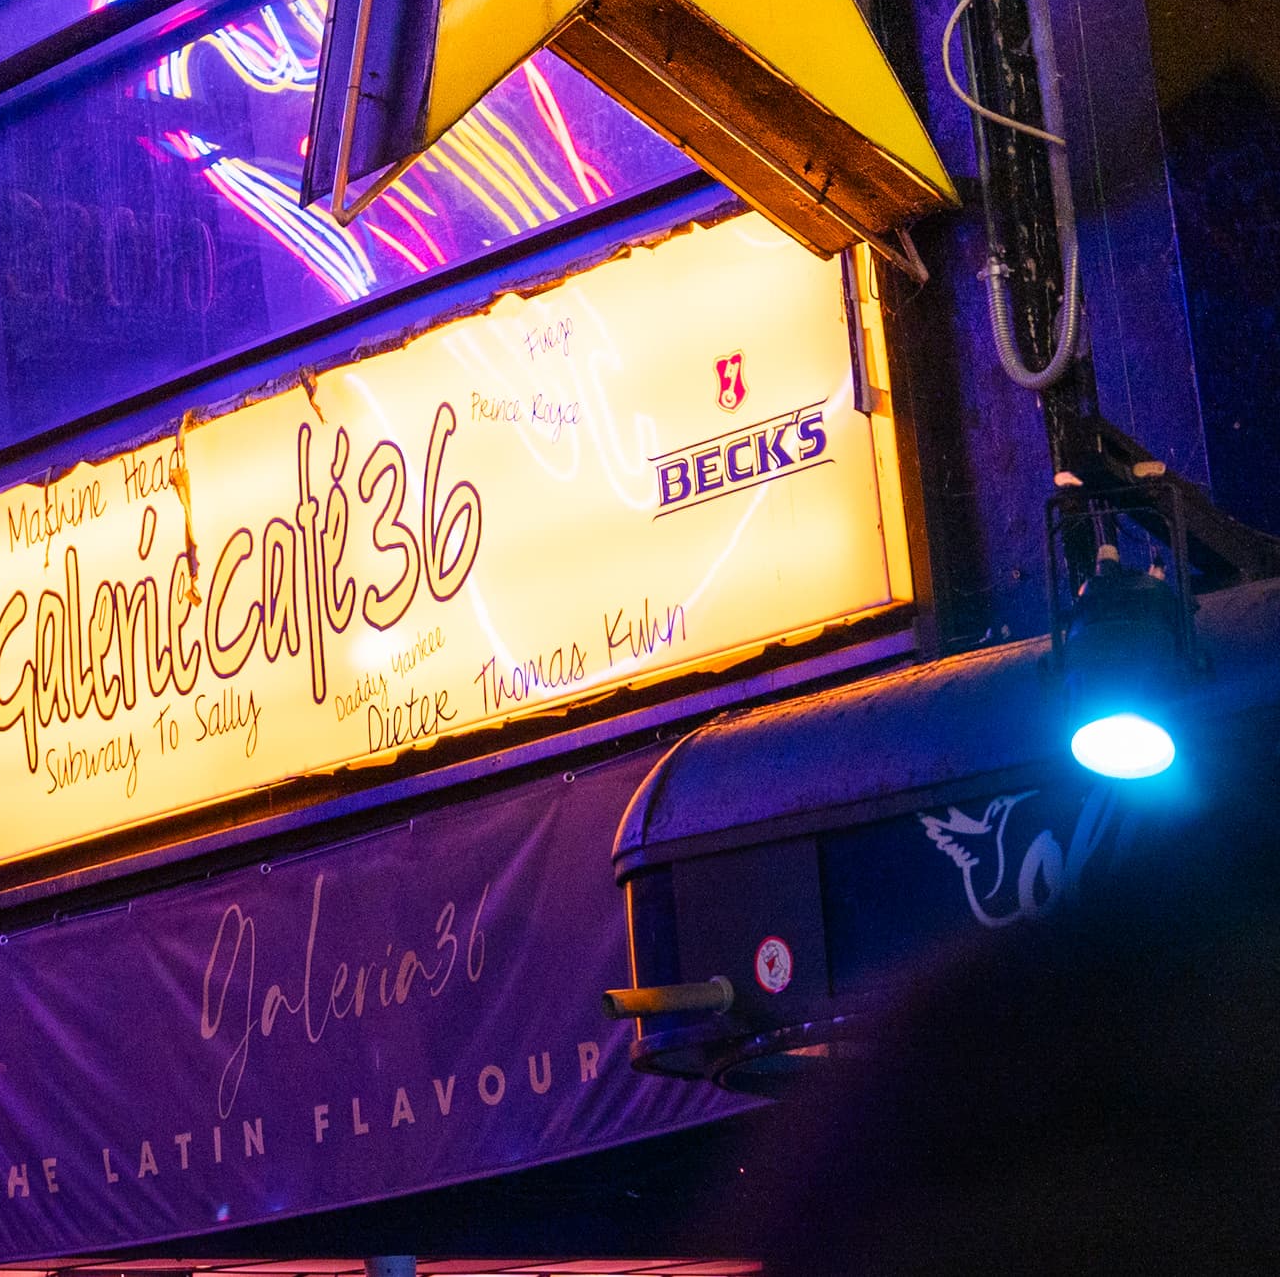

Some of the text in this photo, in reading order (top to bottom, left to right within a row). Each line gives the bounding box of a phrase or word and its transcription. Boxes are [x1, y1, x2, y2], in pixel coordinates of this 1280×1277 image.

[471, 392, 522, 423] Prince
[656, 409, 828, 506] BECK'S
[45, 732, 141, 795] Subway
[194, 686, 262, 758] Sally
[367, 688, 458, 755] Dieter
[474, 642, 587, 715] Thomas
[102, 1117, 266, 1185] LATIN
